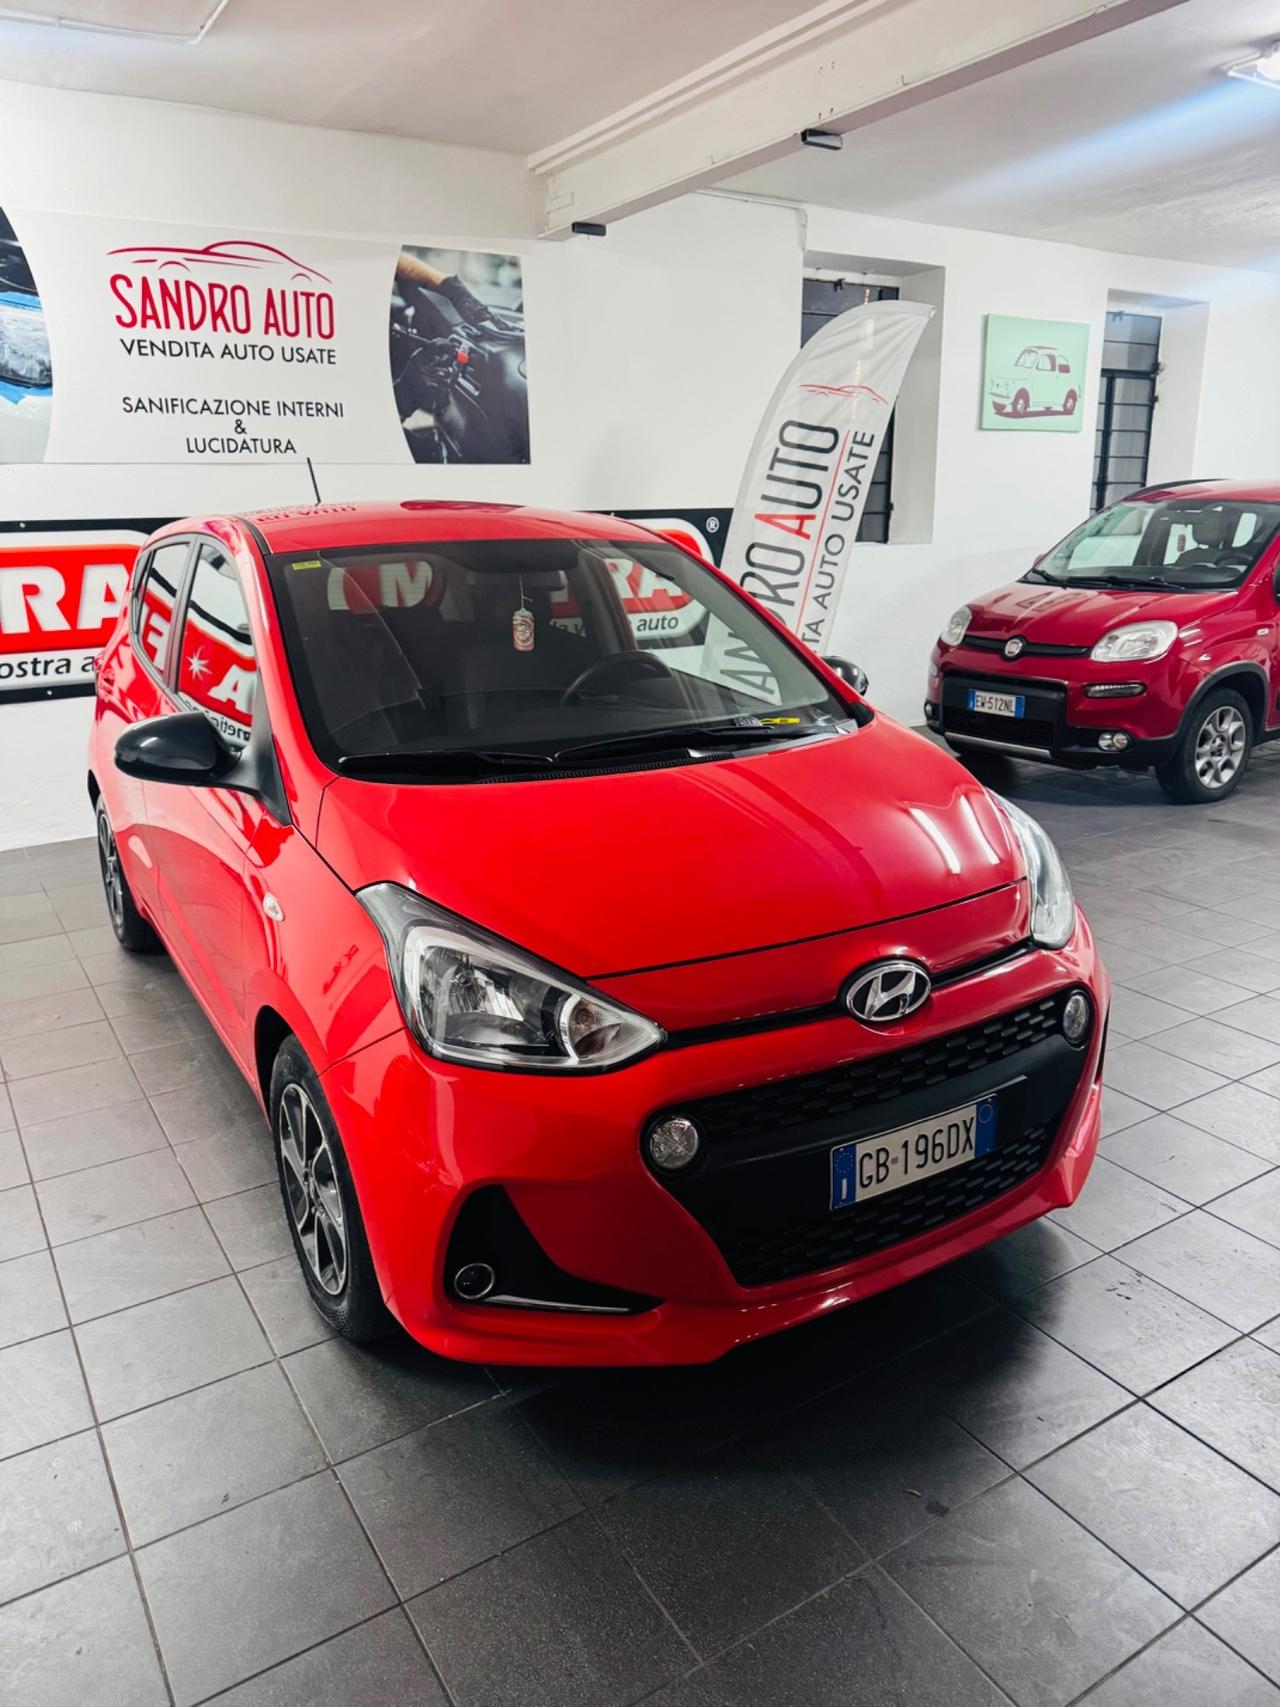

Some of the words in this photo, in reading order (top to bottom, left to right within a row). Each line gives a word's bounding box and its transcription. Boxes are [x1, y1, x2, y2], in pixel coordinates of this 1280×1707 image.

[109, 273, 252, 335] SANDRO
[263, 287, 336, 340] AUTO
[119, 338, 215, 359] VENDITA
[220, 343, 275, 362] AUTO
[281, 346, 337, 365] USATE
[121, 396, 272, 416] SANIFICAZIONE
[277, 401, 344, 418] INTERNI
[234, 418, 248, 435] &
[186, 437, 297, 454] LUCIDATURA
[754, 419, 840, 541] AUTO
[813, 533, 846, 613] AUTO
[831, 430, 875, 523] USATE
[636, 615, 680, 633] auto
[0, 656, 71, 679] ostra
